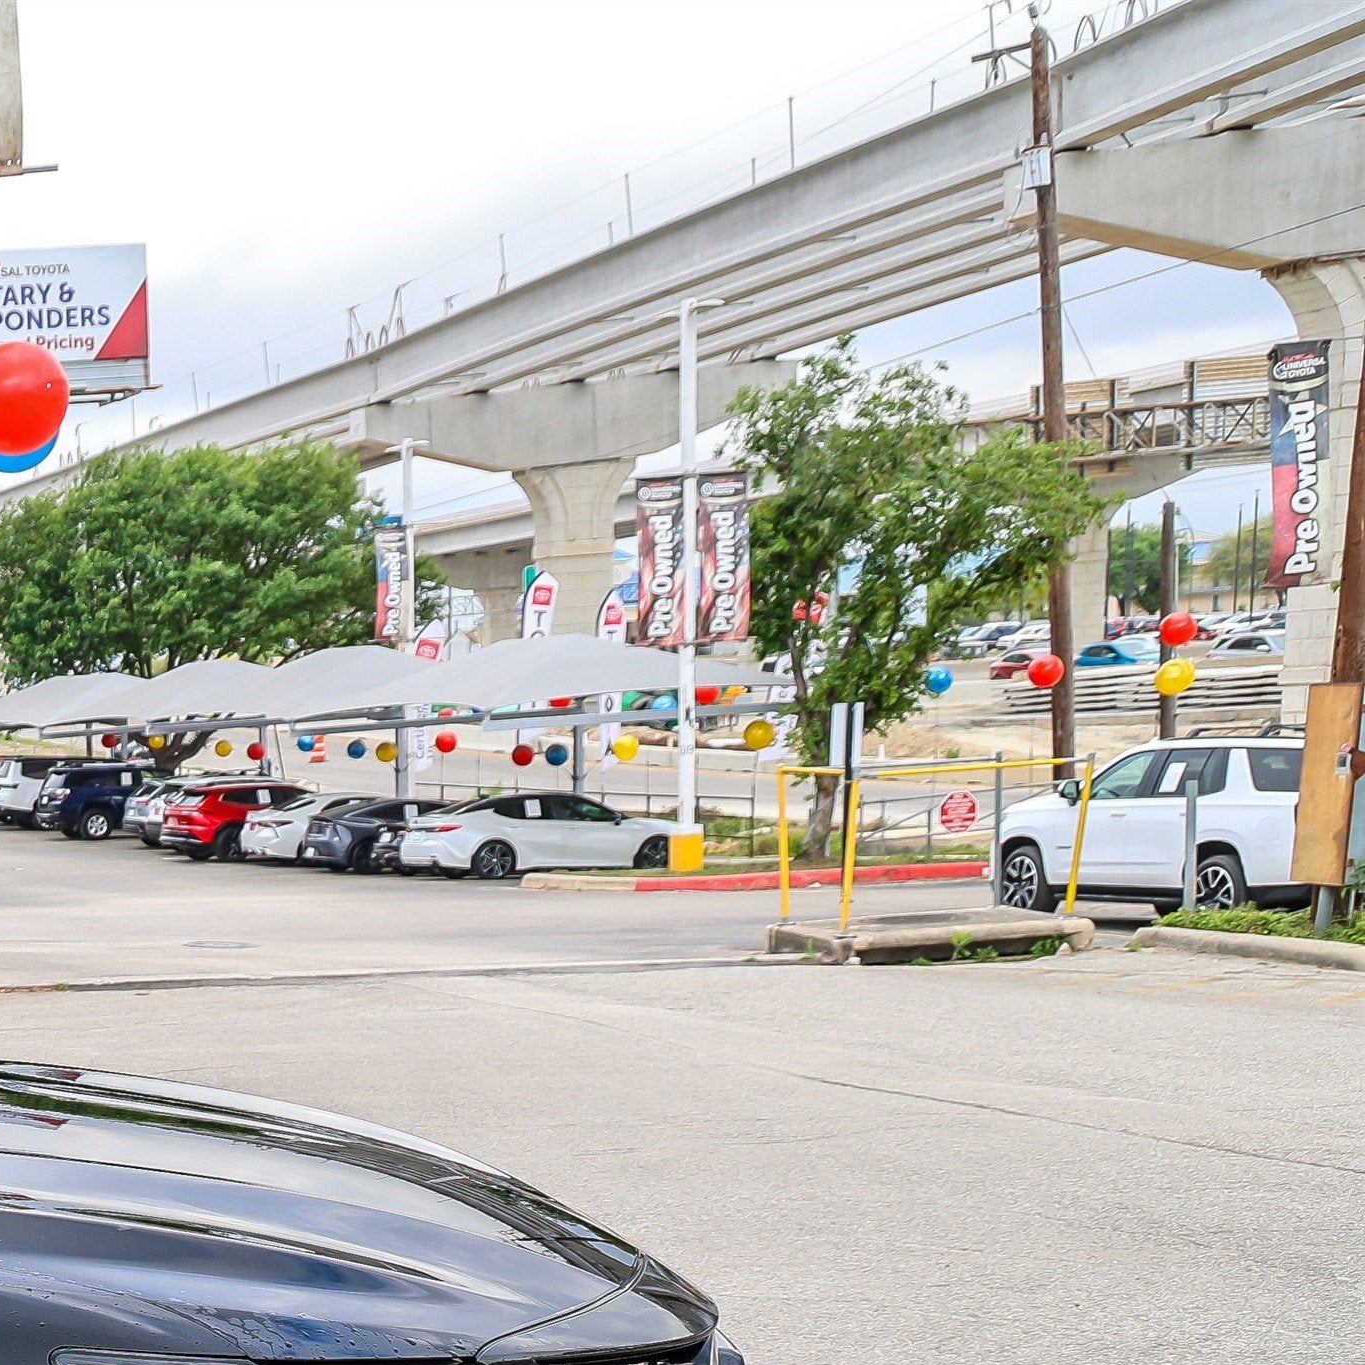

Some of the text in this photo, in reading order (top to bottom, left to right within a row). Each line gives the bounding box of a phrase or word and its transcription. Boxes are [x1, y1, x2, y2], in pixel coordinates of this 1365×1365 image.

[25, 263, 71, 276] TOYOTA
[59, 281, 76, 303] &
[35, 333, 96, 352] Pricing
[1288, 399, 1319, 515] Owned
[647, 514, 674, 596] Owned
[709, 511, 736, 592] Owned
[1283, 515, 1319, 577] Pre
[381, 550, 401, 637] Pre Owned
[647, 597, 674, 637] Pre
[709, 593, 736, 634] Pre
